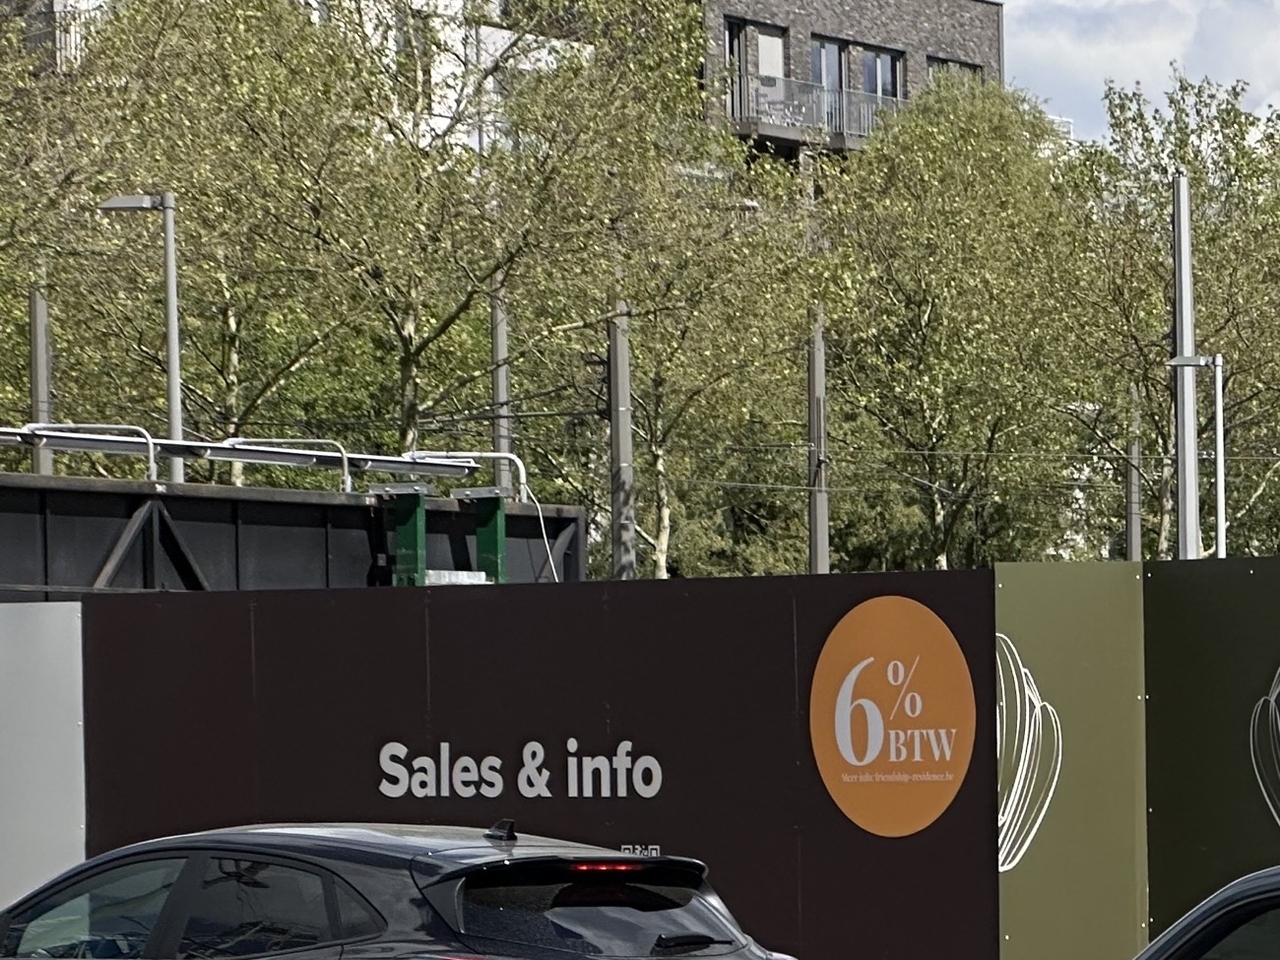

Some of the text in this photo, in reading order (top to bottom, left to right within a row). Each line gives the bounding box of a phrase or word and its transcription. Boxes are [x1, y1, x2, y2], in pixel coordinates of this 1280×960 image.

[834, 655, 922, 767] 6%
[378, 737, 663, 798] Sales & info
[888, 729, 958, 762] BTW
